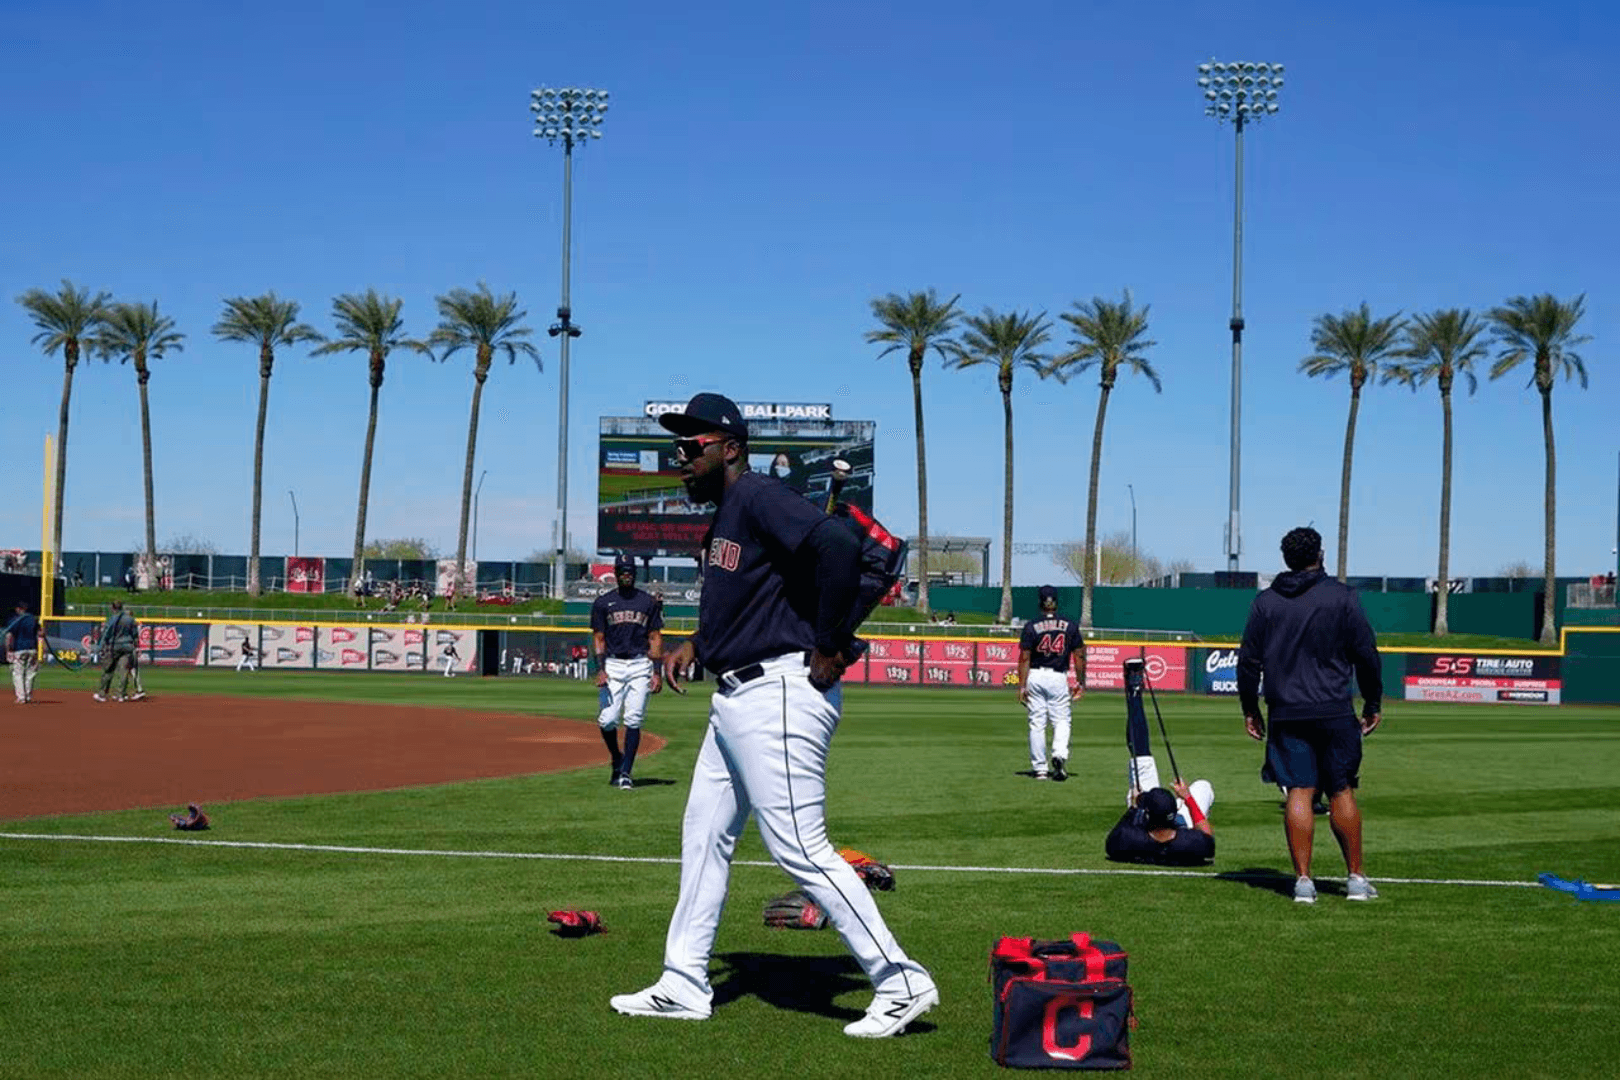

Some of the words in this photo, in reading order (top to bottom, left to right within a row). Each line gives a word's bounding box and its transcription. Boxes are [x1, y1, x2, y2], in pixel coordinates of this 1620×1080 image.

[744, 405, 830, 417] BALLPARK
[1037, 634, 1065, 657] 44
[59, 650, 76, 660] 345
[1476, 658, 1499, 668] TIRE
[1505, 659, 1534, 669] AUTO
[1042, 994, 1094, 1061] C
